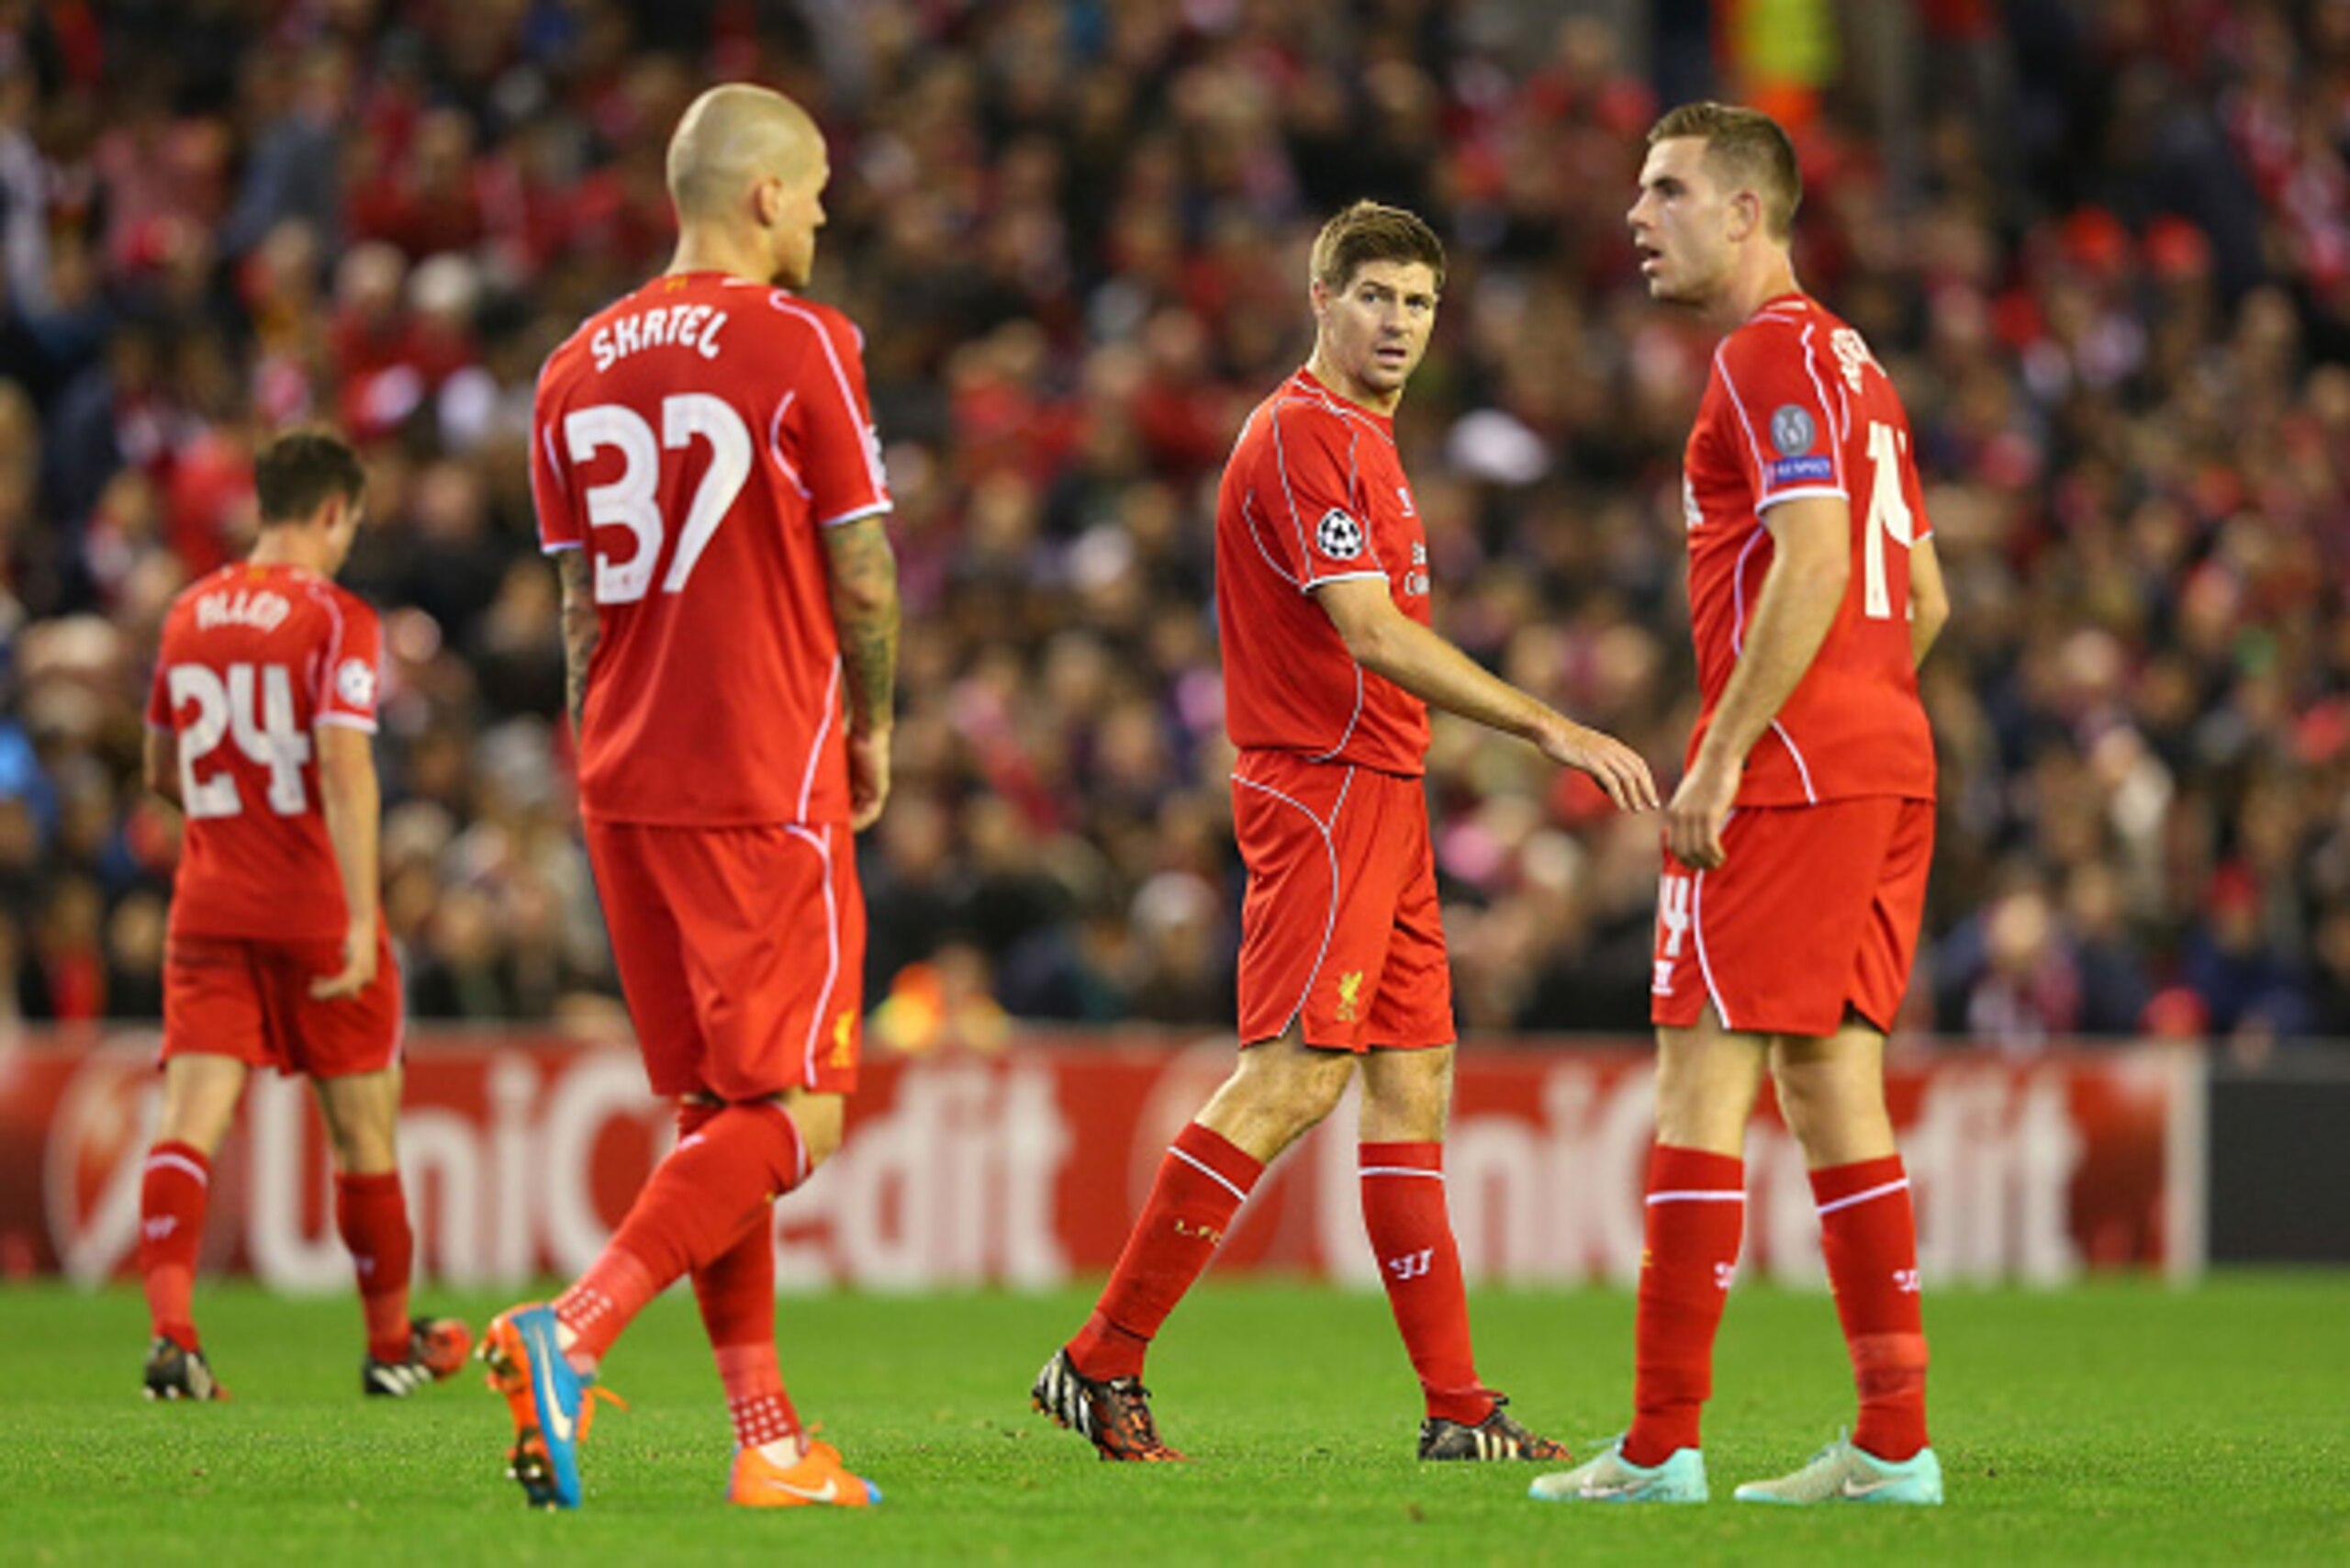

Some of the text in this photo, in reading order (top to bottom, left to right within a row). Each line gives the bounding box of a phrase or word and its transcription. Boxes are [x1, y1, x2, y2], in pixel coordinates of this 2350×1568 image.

[564, 392, 753, 605] 37
[168, 662, 311, 819] 24
[248, 1052, 1072, 1293] UniCedit
